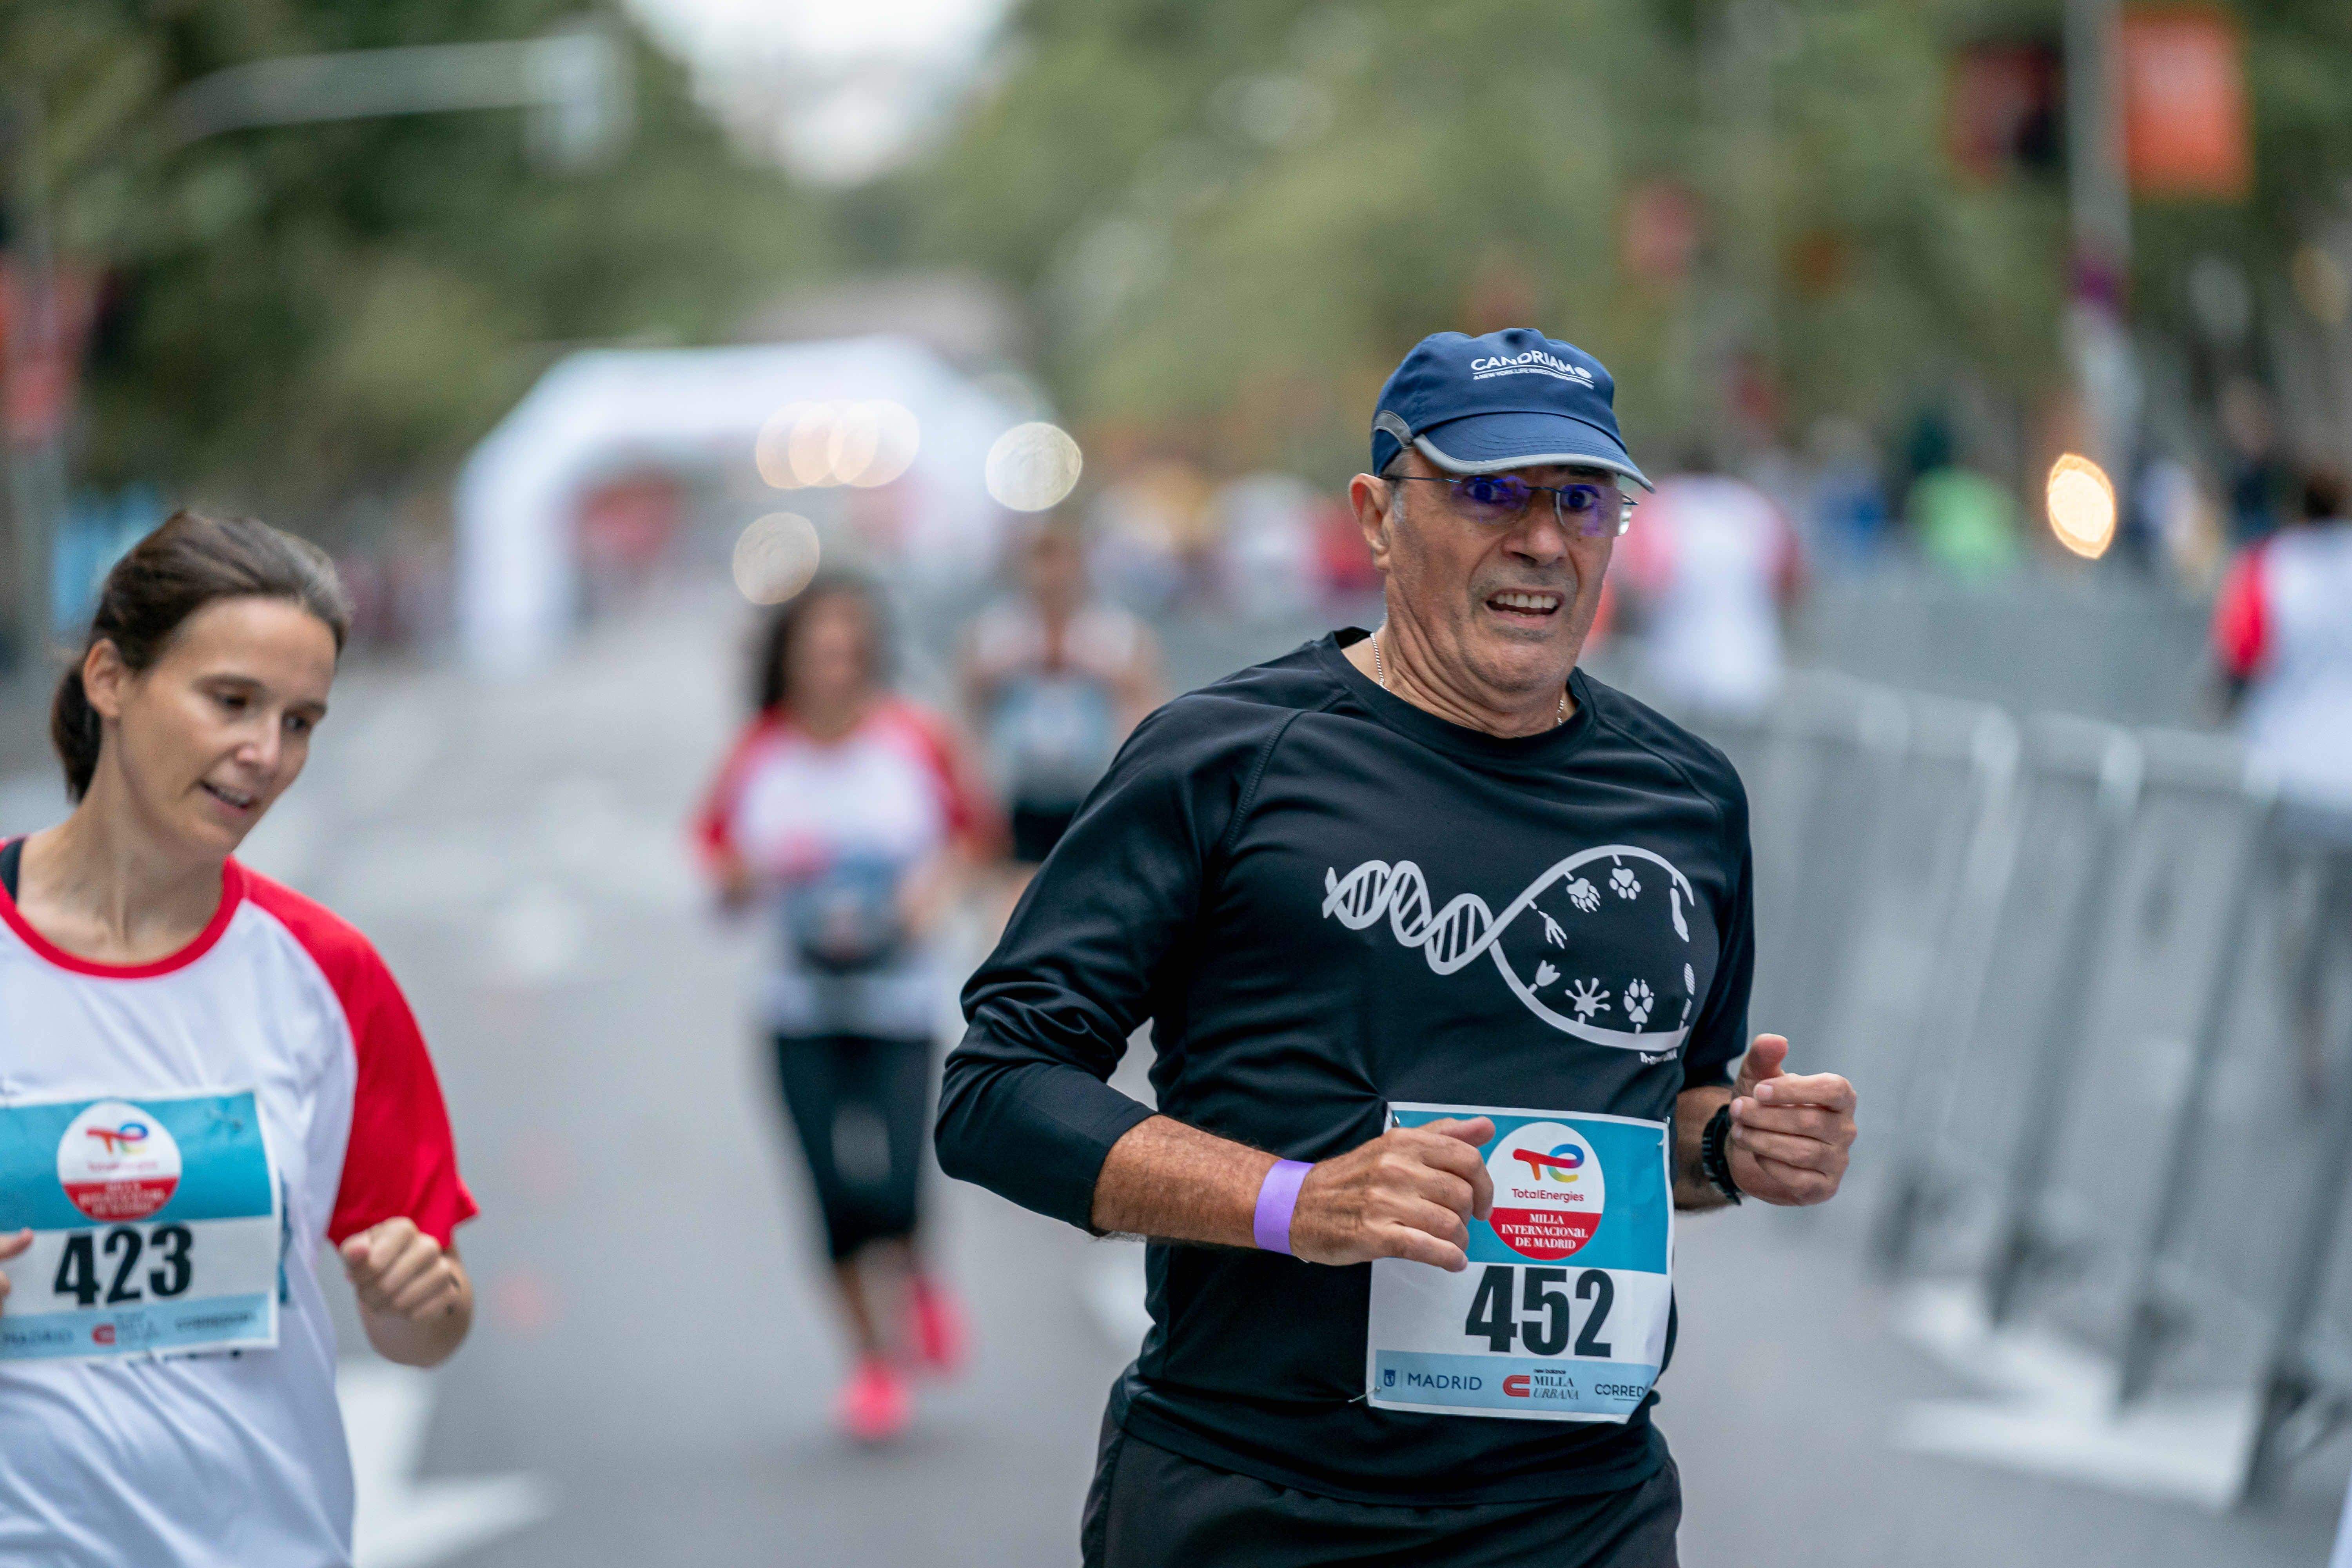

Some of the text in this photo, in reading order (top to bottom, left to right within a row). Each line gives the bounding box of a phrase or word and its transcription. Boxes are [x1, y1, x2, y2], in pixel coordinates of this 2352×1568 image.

[1470, 350, 1576, 374] CANDRIAM
[1512, 1189, 1584, 1203] TotalEnergies
[1530, 1213, 1564, 1225] MILLA
[1515, 1237, 1577, 1249] DE MADRID
[54, 1224, 193, 1307] 423
[1465, 1265, 1615, 1358] 452
[1408, 1372, 1482, 1390] MADRID
[1534, 1376, 1574, 1387] MILLA
[1595, 1383, 1648, 1397] CORRED
